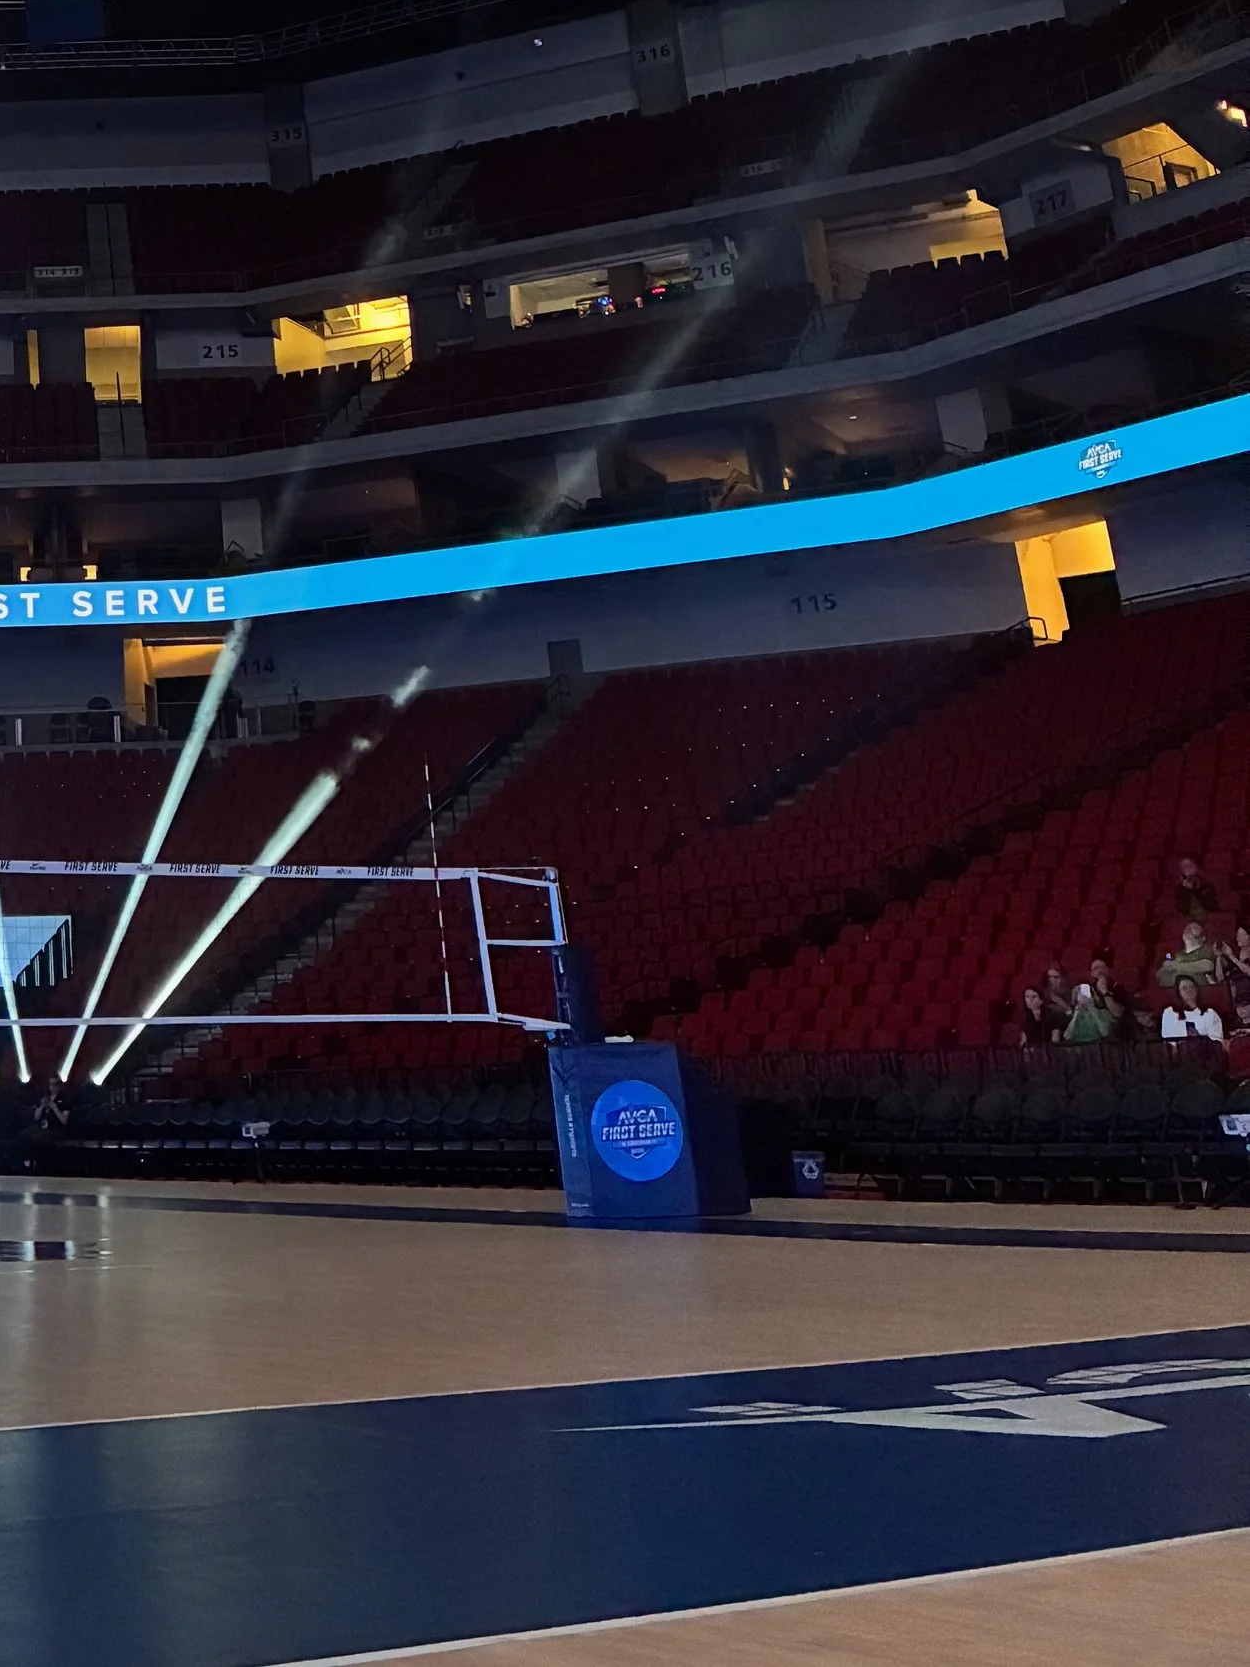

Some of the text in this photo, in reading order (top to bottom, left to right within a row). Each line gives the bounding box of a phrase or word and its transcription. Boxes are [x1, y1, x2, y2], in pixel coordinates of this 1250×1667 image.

[637, 45, 670, 63] 316
[271, 126, 302, 142] 315
[1036, 189, 1069, 215] 217
[692, 261, 732, 281] 216
[203, 344, 238, 359] 215
[1086, 442, 1111, 459] AVCA
[1078, 455, 1099, 471] FIRST
[1099, 449, 1122, 465] SERVE
[73, 586, 227, 617] SERVE
[791, 593, 837, 615] 115
[239, 657, 276, 677] 114
[65, 861, 119, 872] FIRST SERVE
[170, 864, 221, 874] FIRST SERVE
[270, 866, 319, 876] FIRST SERVE
[367, 866, 414, 877] FIRST SERVE
[617, 1109, 658, 1125] AVCA
[602, 1121, 676, 1141] FIRST SERVE
